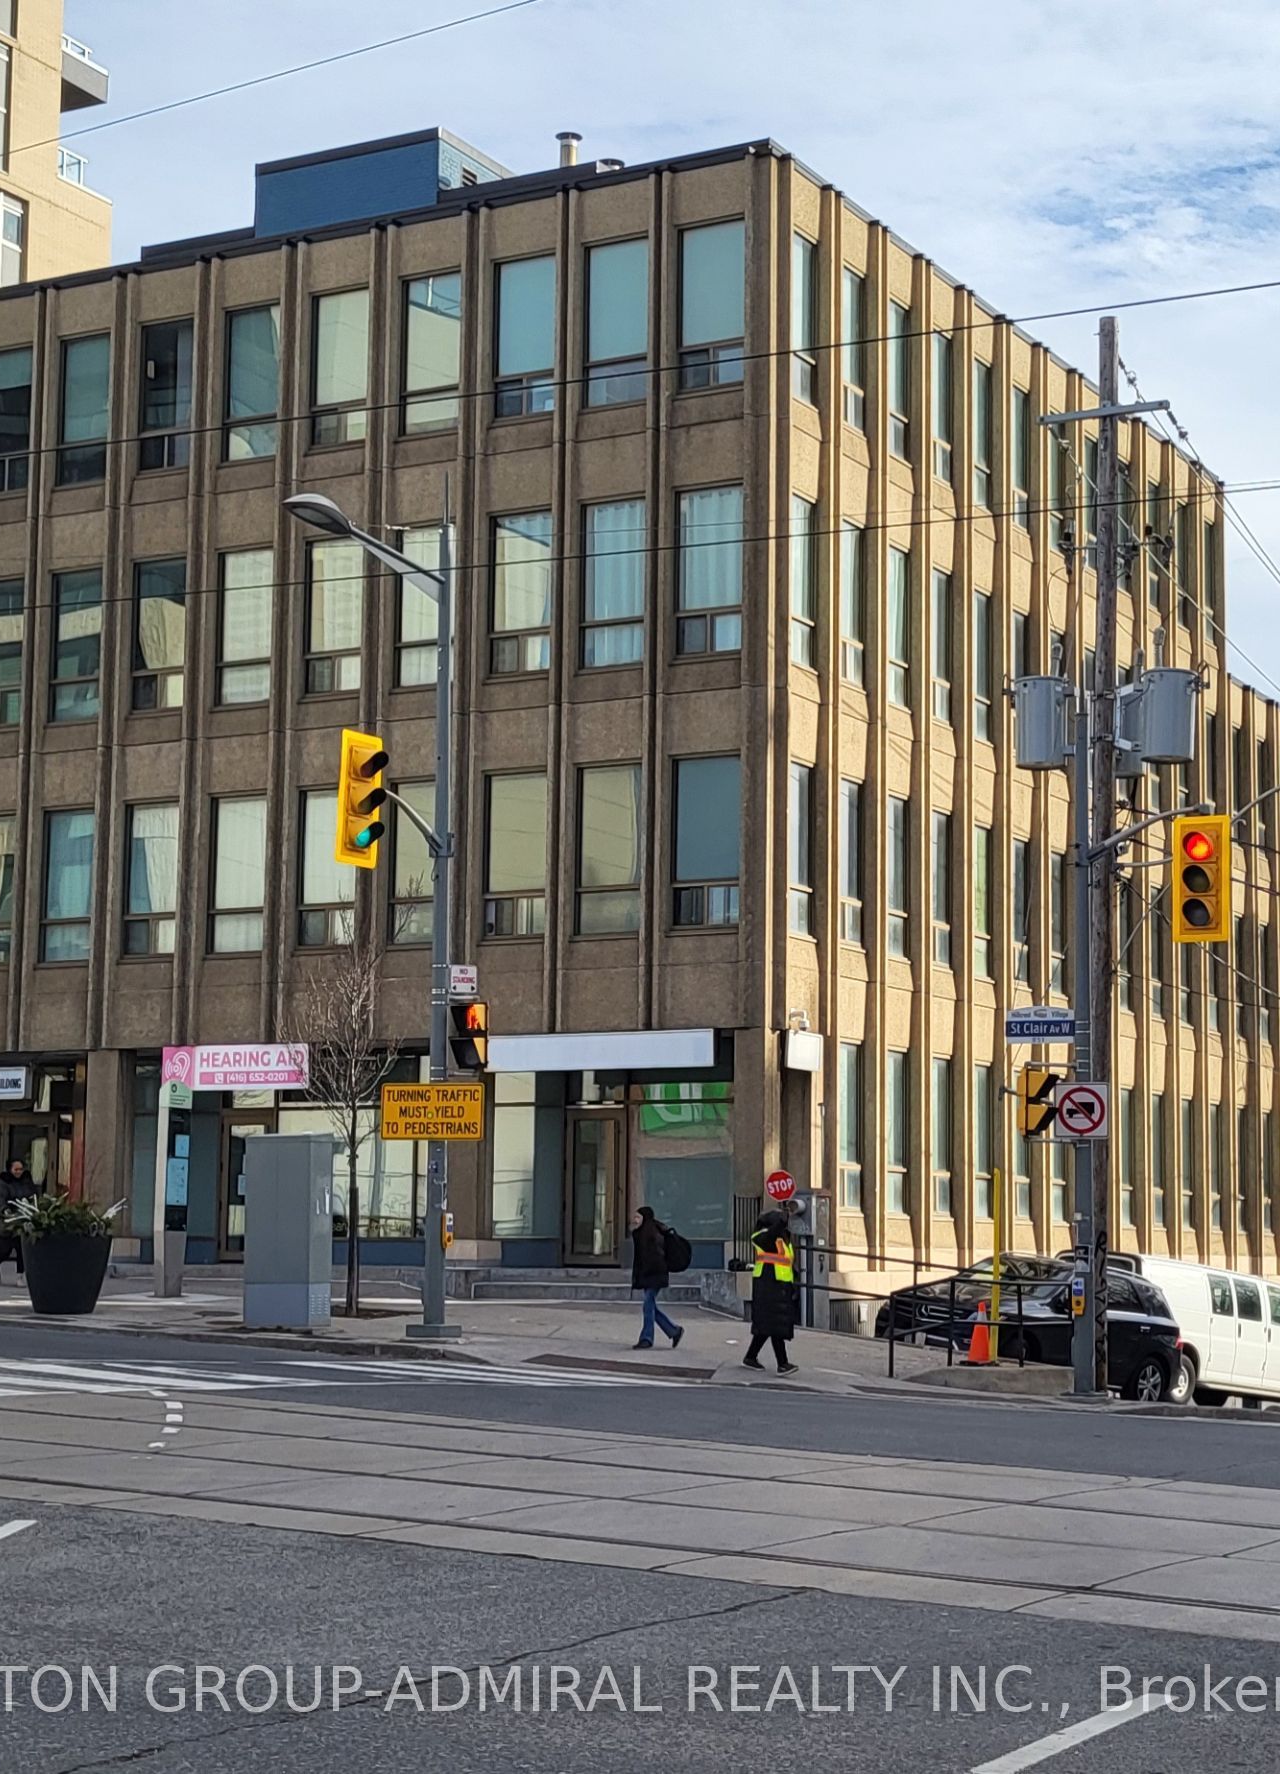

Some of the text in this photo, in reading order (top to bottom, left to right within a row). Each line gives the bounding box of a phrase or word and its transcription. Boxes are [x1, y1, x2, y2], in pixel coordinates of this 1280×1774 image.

[459, 967, 469, 975] NO
[1010, 1022, 1070, 1034] St Clair Av W
[200, 1051, 305, 1068] HEARING AID
[226, 1072, 288, 1083] (416) 652-0201
[387, 1089, 479, 1102] TURNING TRAFFIC
[399, 1106, 465, 1119] MUST YIELD
[385, 1122, 478, 1135] TO PEDESTRIANS
[767, 1178, 793, 1194] STOP
